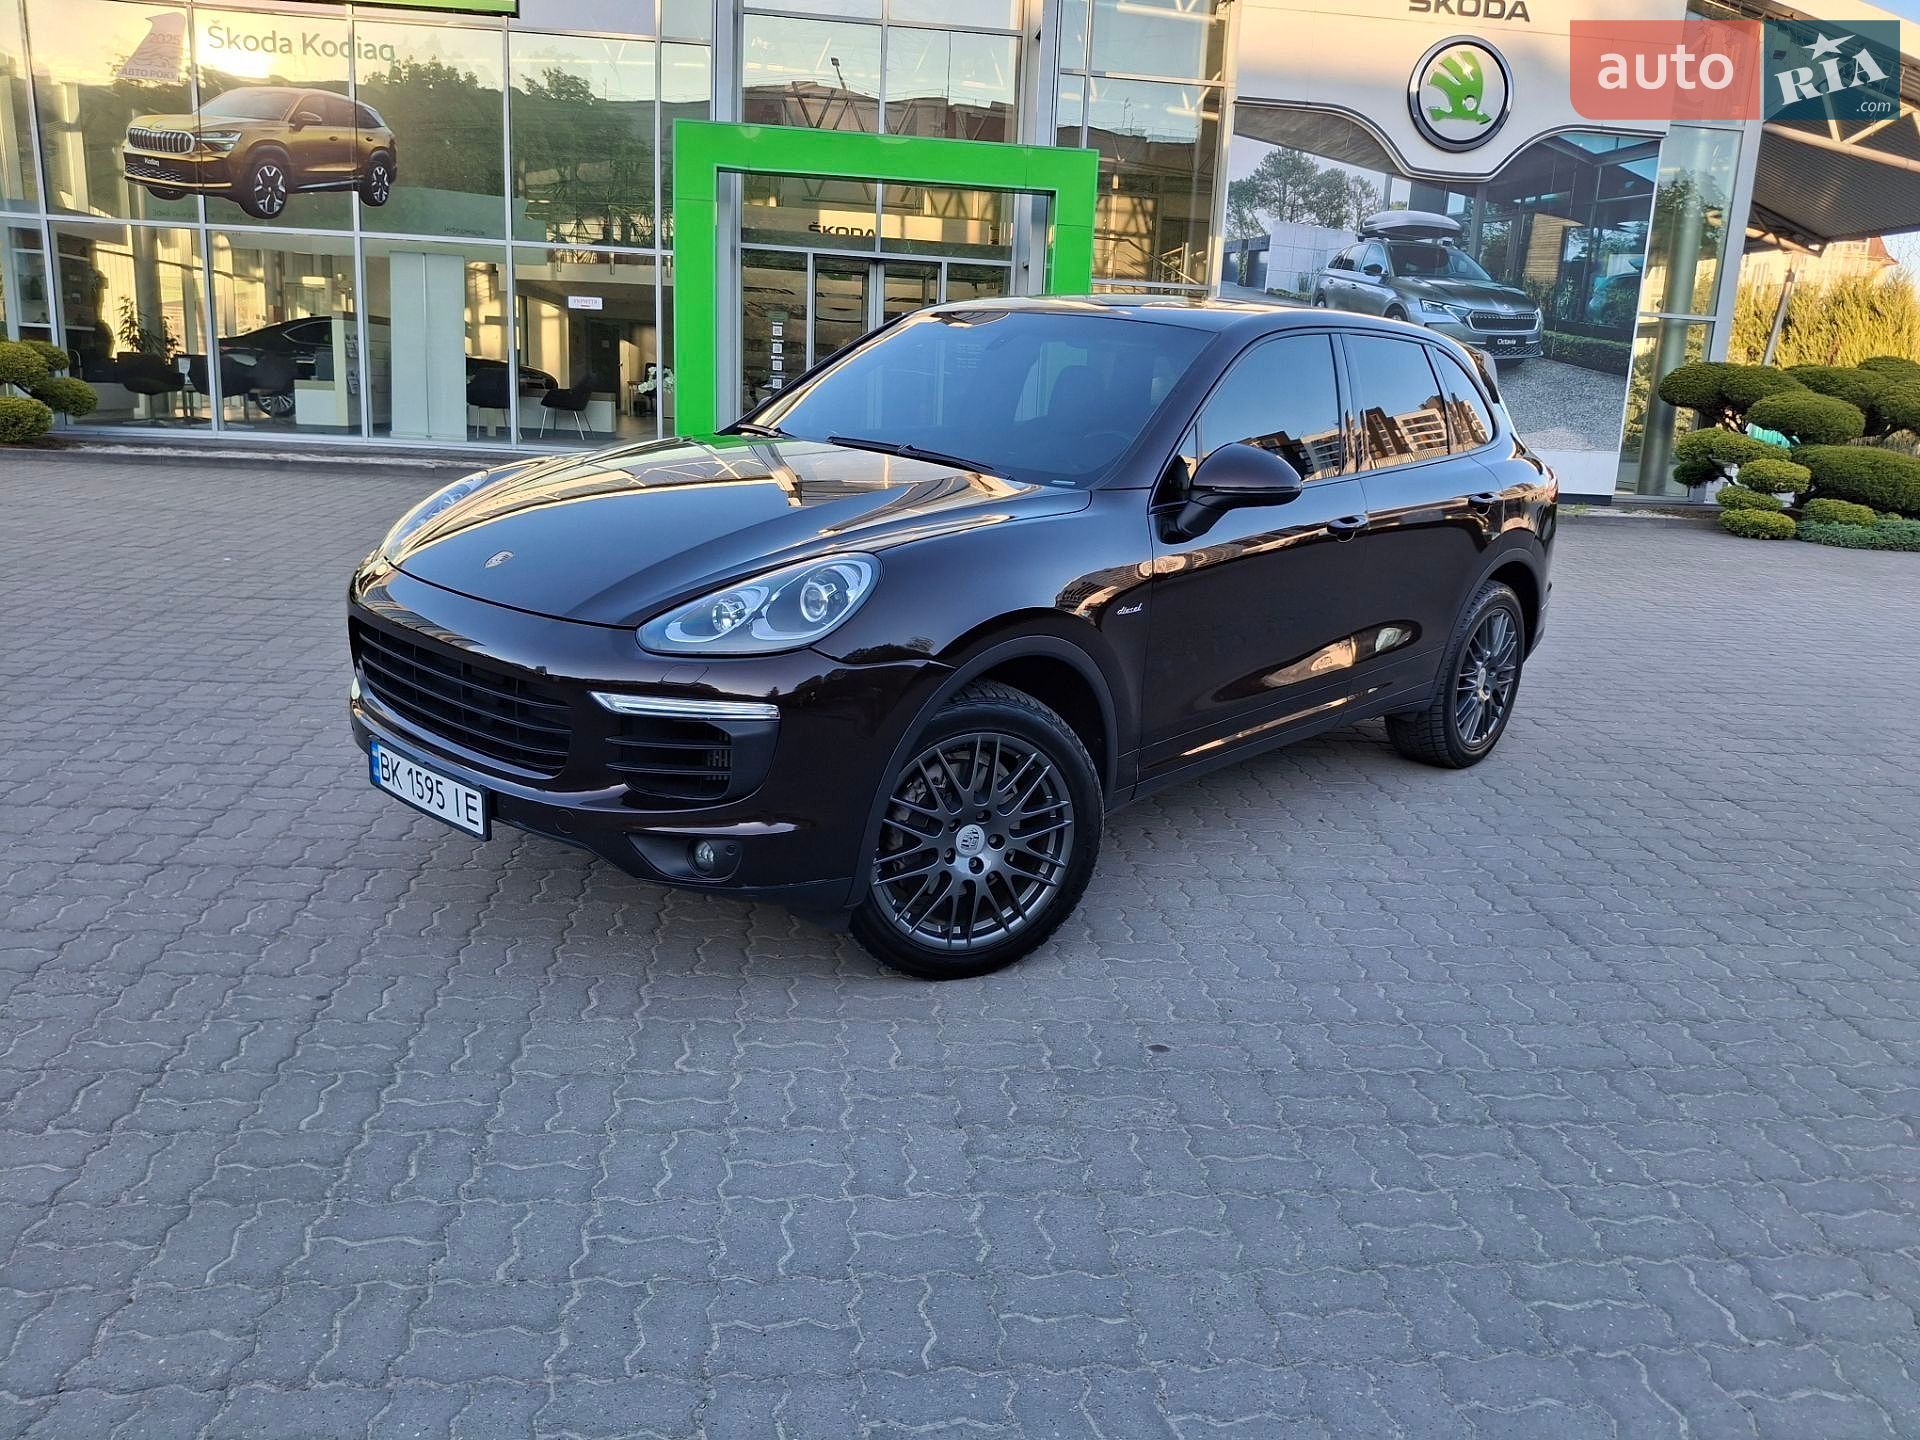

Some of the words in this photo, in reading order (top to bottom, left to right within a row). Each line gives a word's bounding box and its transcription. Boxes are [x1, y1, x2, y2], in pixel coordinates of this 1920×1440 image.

[208, 20, 293, 54] Škoda
[302, 32, 396, 66] Kodiaq
[808, 221, 876, 238] ŠKODA
[408, 767, 446, 810] 1595
[455, 787, 479, 826] IE
